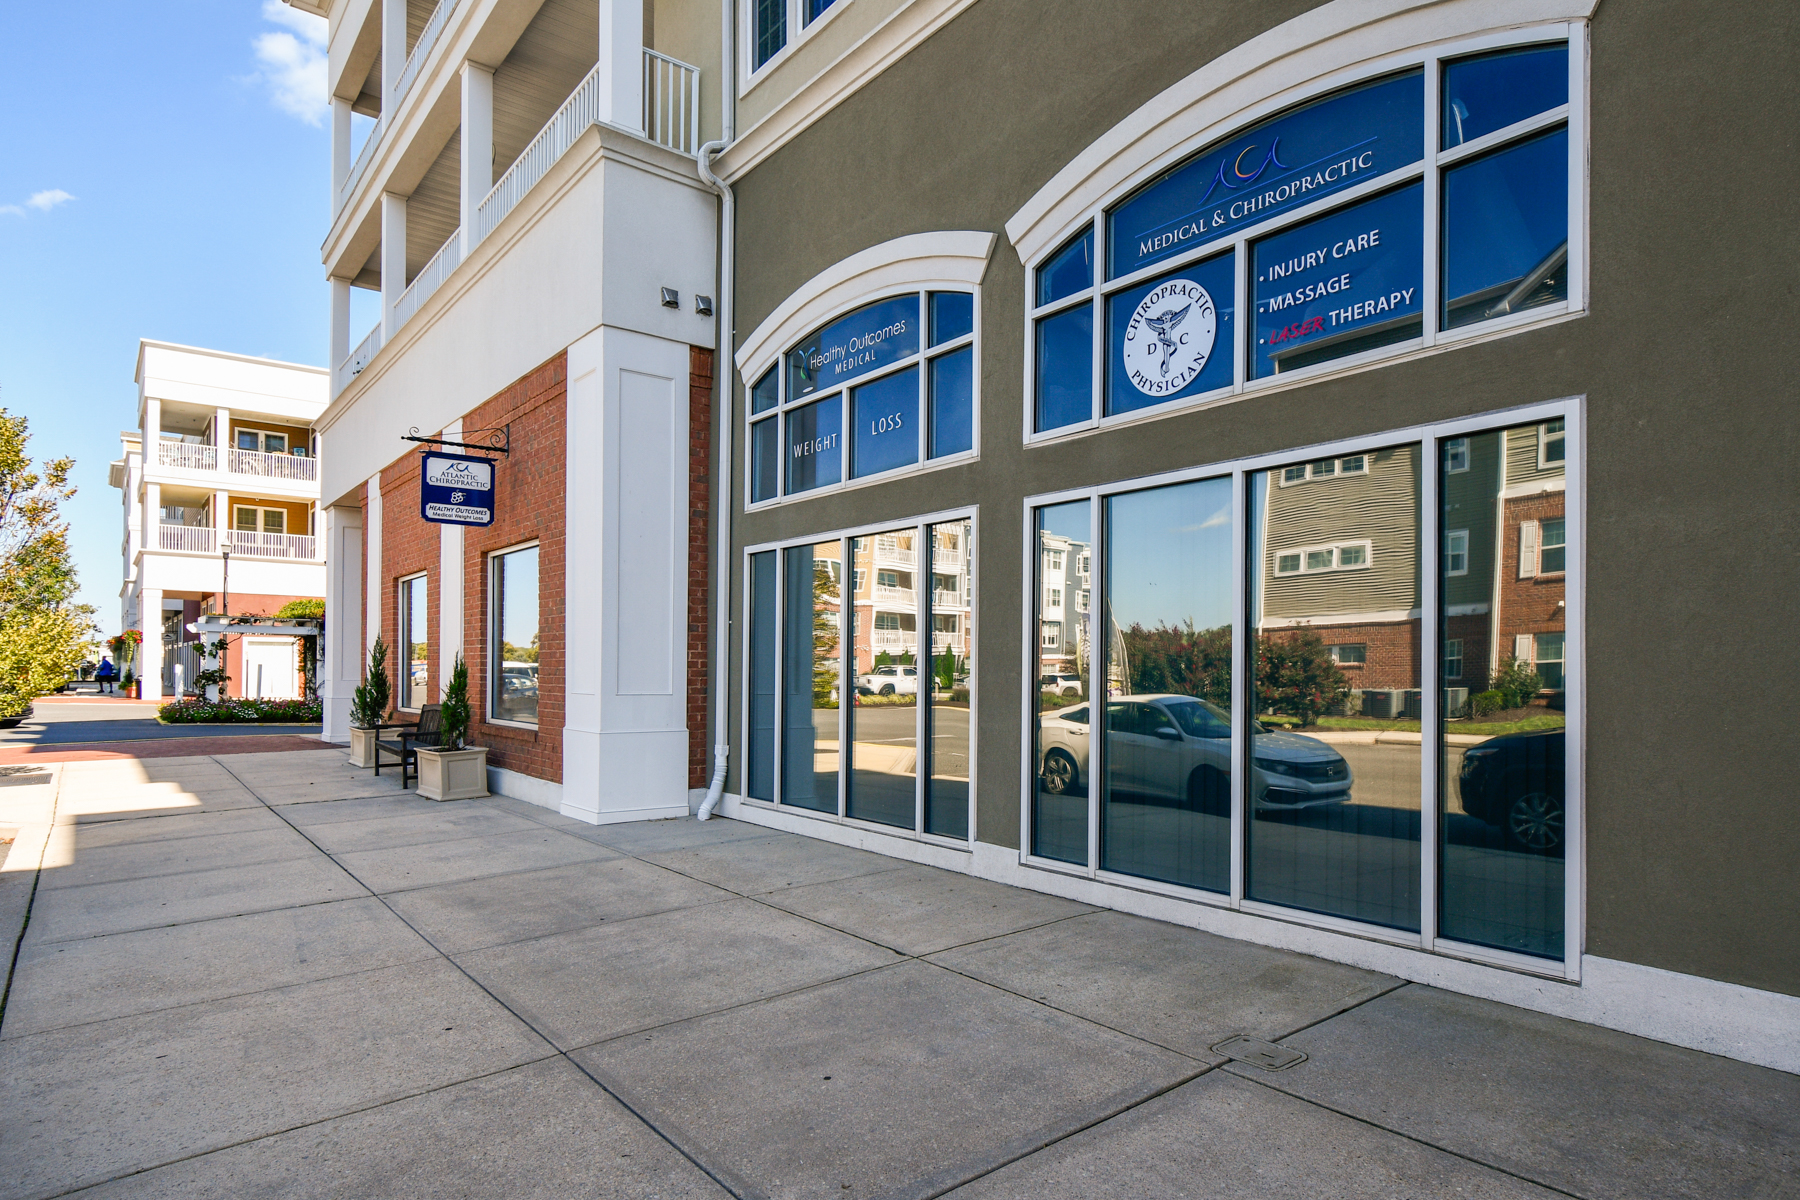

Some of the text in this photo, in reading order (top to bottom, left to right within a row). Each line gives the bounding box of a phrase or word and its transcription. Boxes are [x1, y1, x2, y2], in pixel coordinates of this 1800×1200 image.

[1139, 151, 1373, 257] MEDICAL & CHIROPRACTIC
[1269, 229, 1380, 281] INJURY CARE
[1126, 284, 1213, 341] CHIROPRACTIC
[1269, 273, 1350, 313] MASSAGE
[1269, 287, 1415, 345] LASER THERAPY
[810, 319, 906, 370] Healthy Outcomes
[834, 349, 876, 375] MEDICAL
[1131, 351, 1206, 393] PHYSICIAN
[793, 412, 902, 458] WEIGHT LOSS
[429, 475, 489, 489] CHIROPRACTIC
[440, 471, 479, 481] ATLANTIC
[428, 504, 488, 516] HEALTHY OUTCOMES
